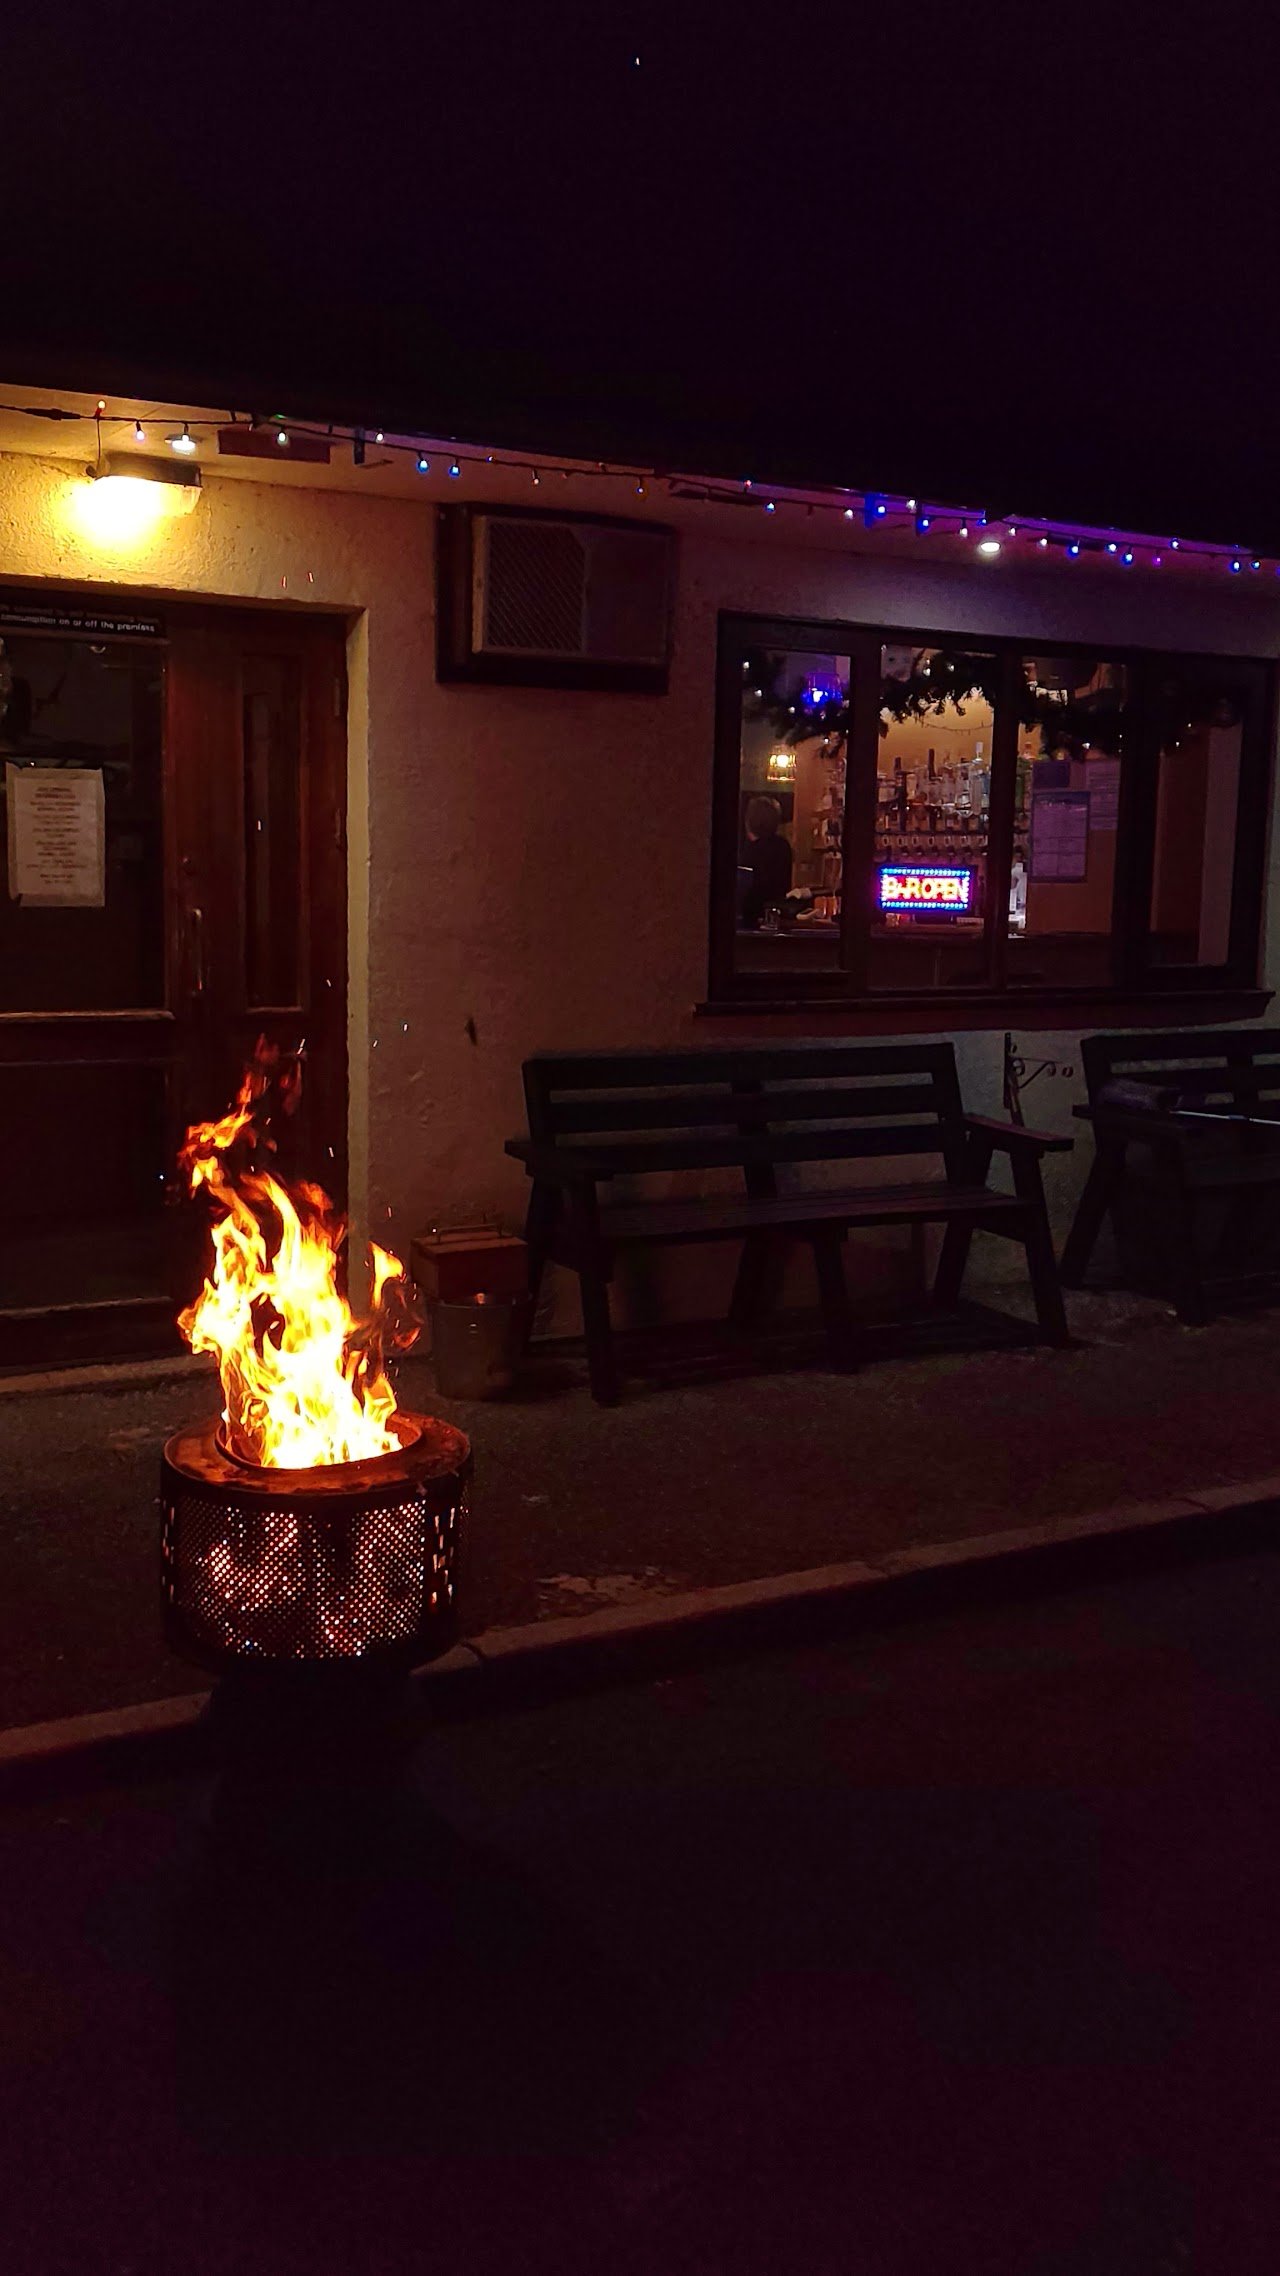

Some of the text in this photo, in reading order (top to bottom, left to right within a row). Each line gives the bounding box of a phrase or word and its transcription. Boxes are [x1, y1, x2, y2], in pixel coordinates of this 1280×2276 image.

[72, 619, 82, 627] or
[84, 619, 97, 628] off
[100, 620, 114, 629] the
[117, 622, 155, 633] premises
[921, 877, 967, 901] OPEN
